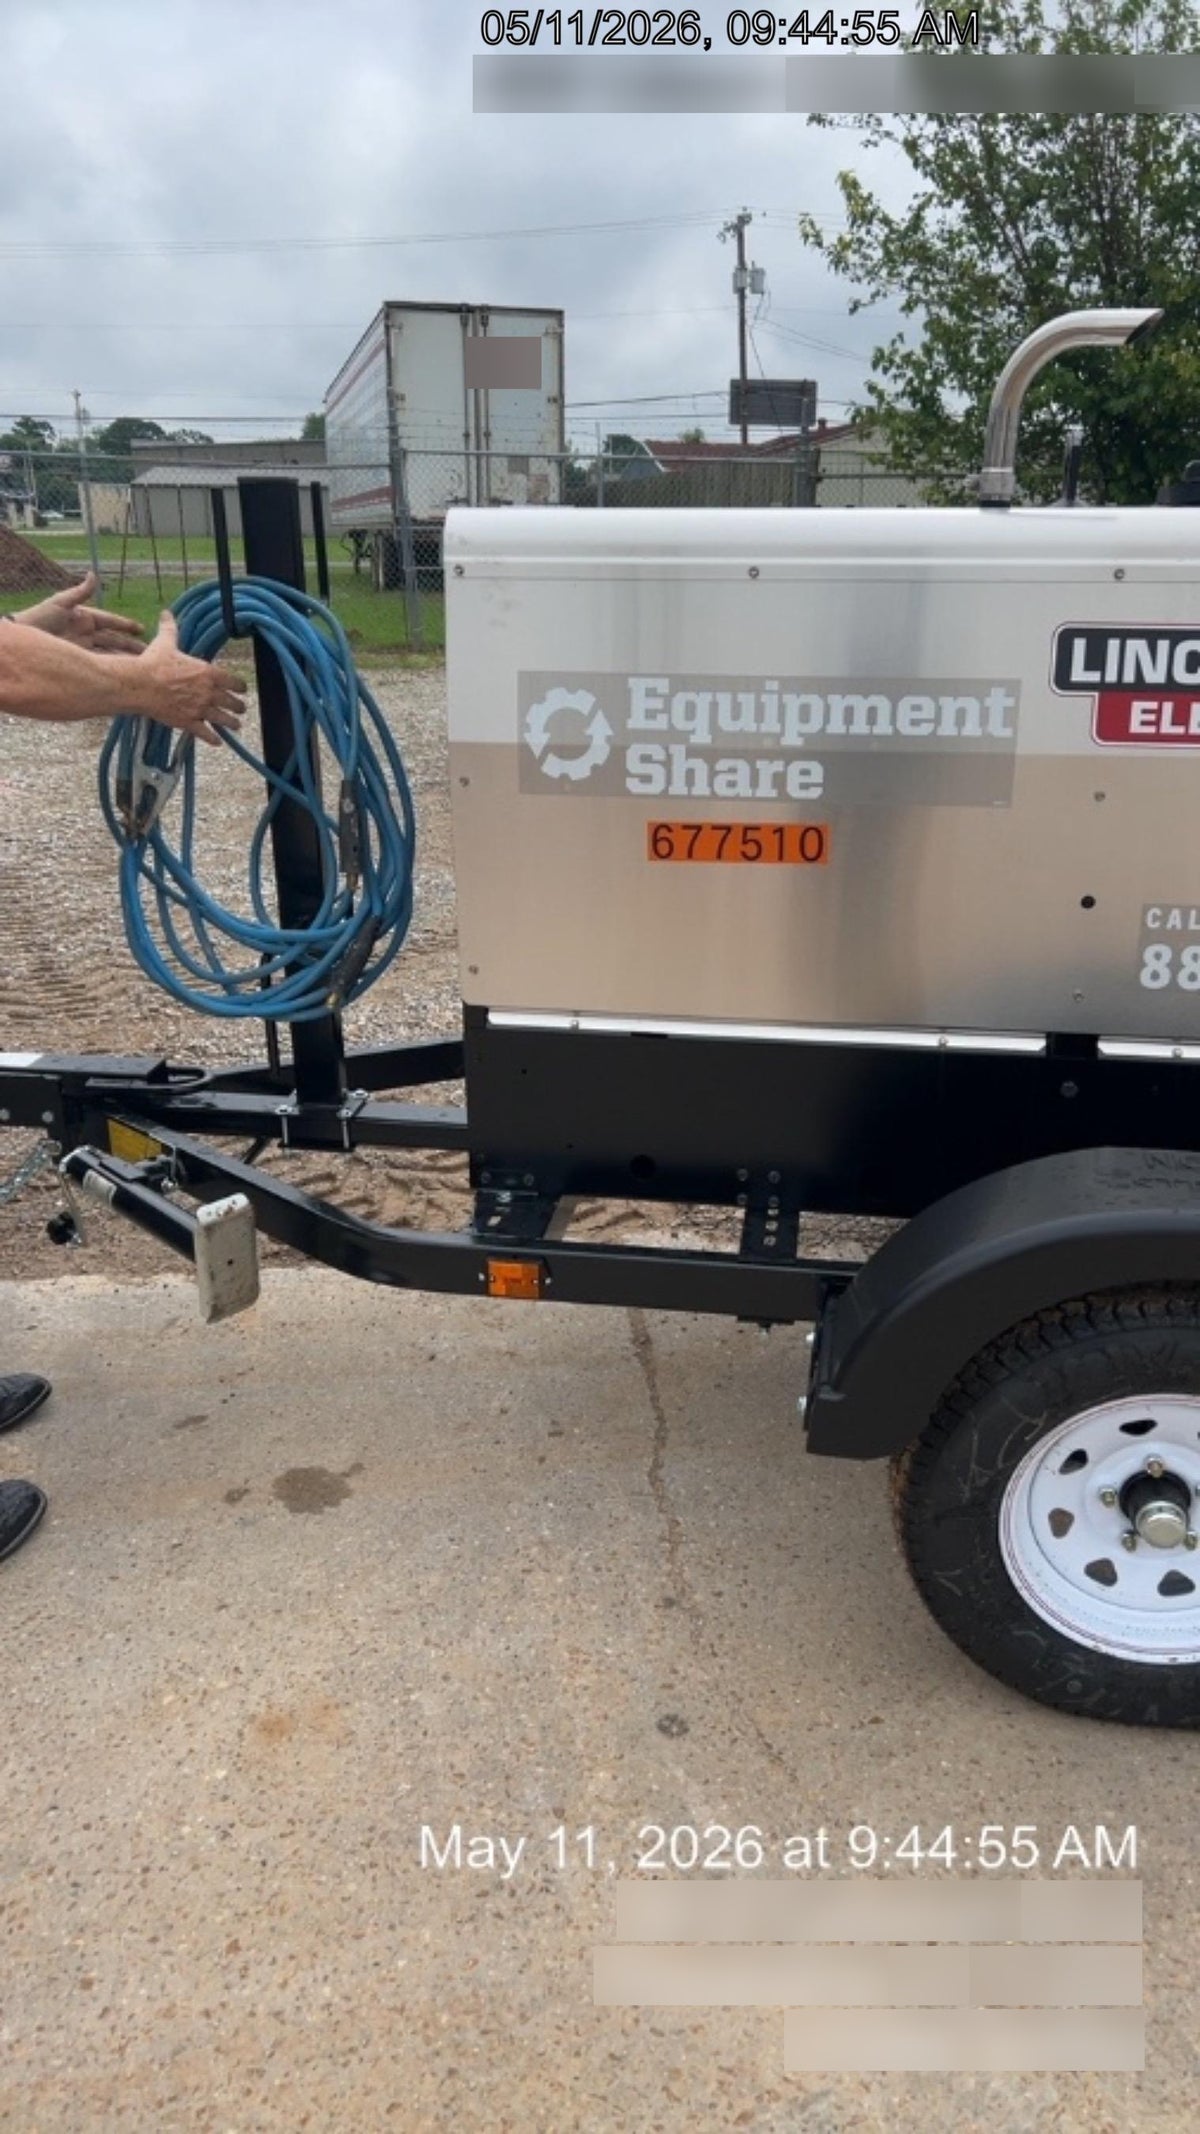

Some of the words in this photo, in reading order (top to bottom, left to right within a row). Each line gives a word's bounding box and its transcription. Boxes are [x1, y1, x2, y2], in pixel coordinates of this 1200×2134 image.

[626, 677, 1016, 745] Equipment
[625, 743, 824, 799] Share
[652, 823, 824, 862] 677510
[1140, 943, 1200, 990] 88
